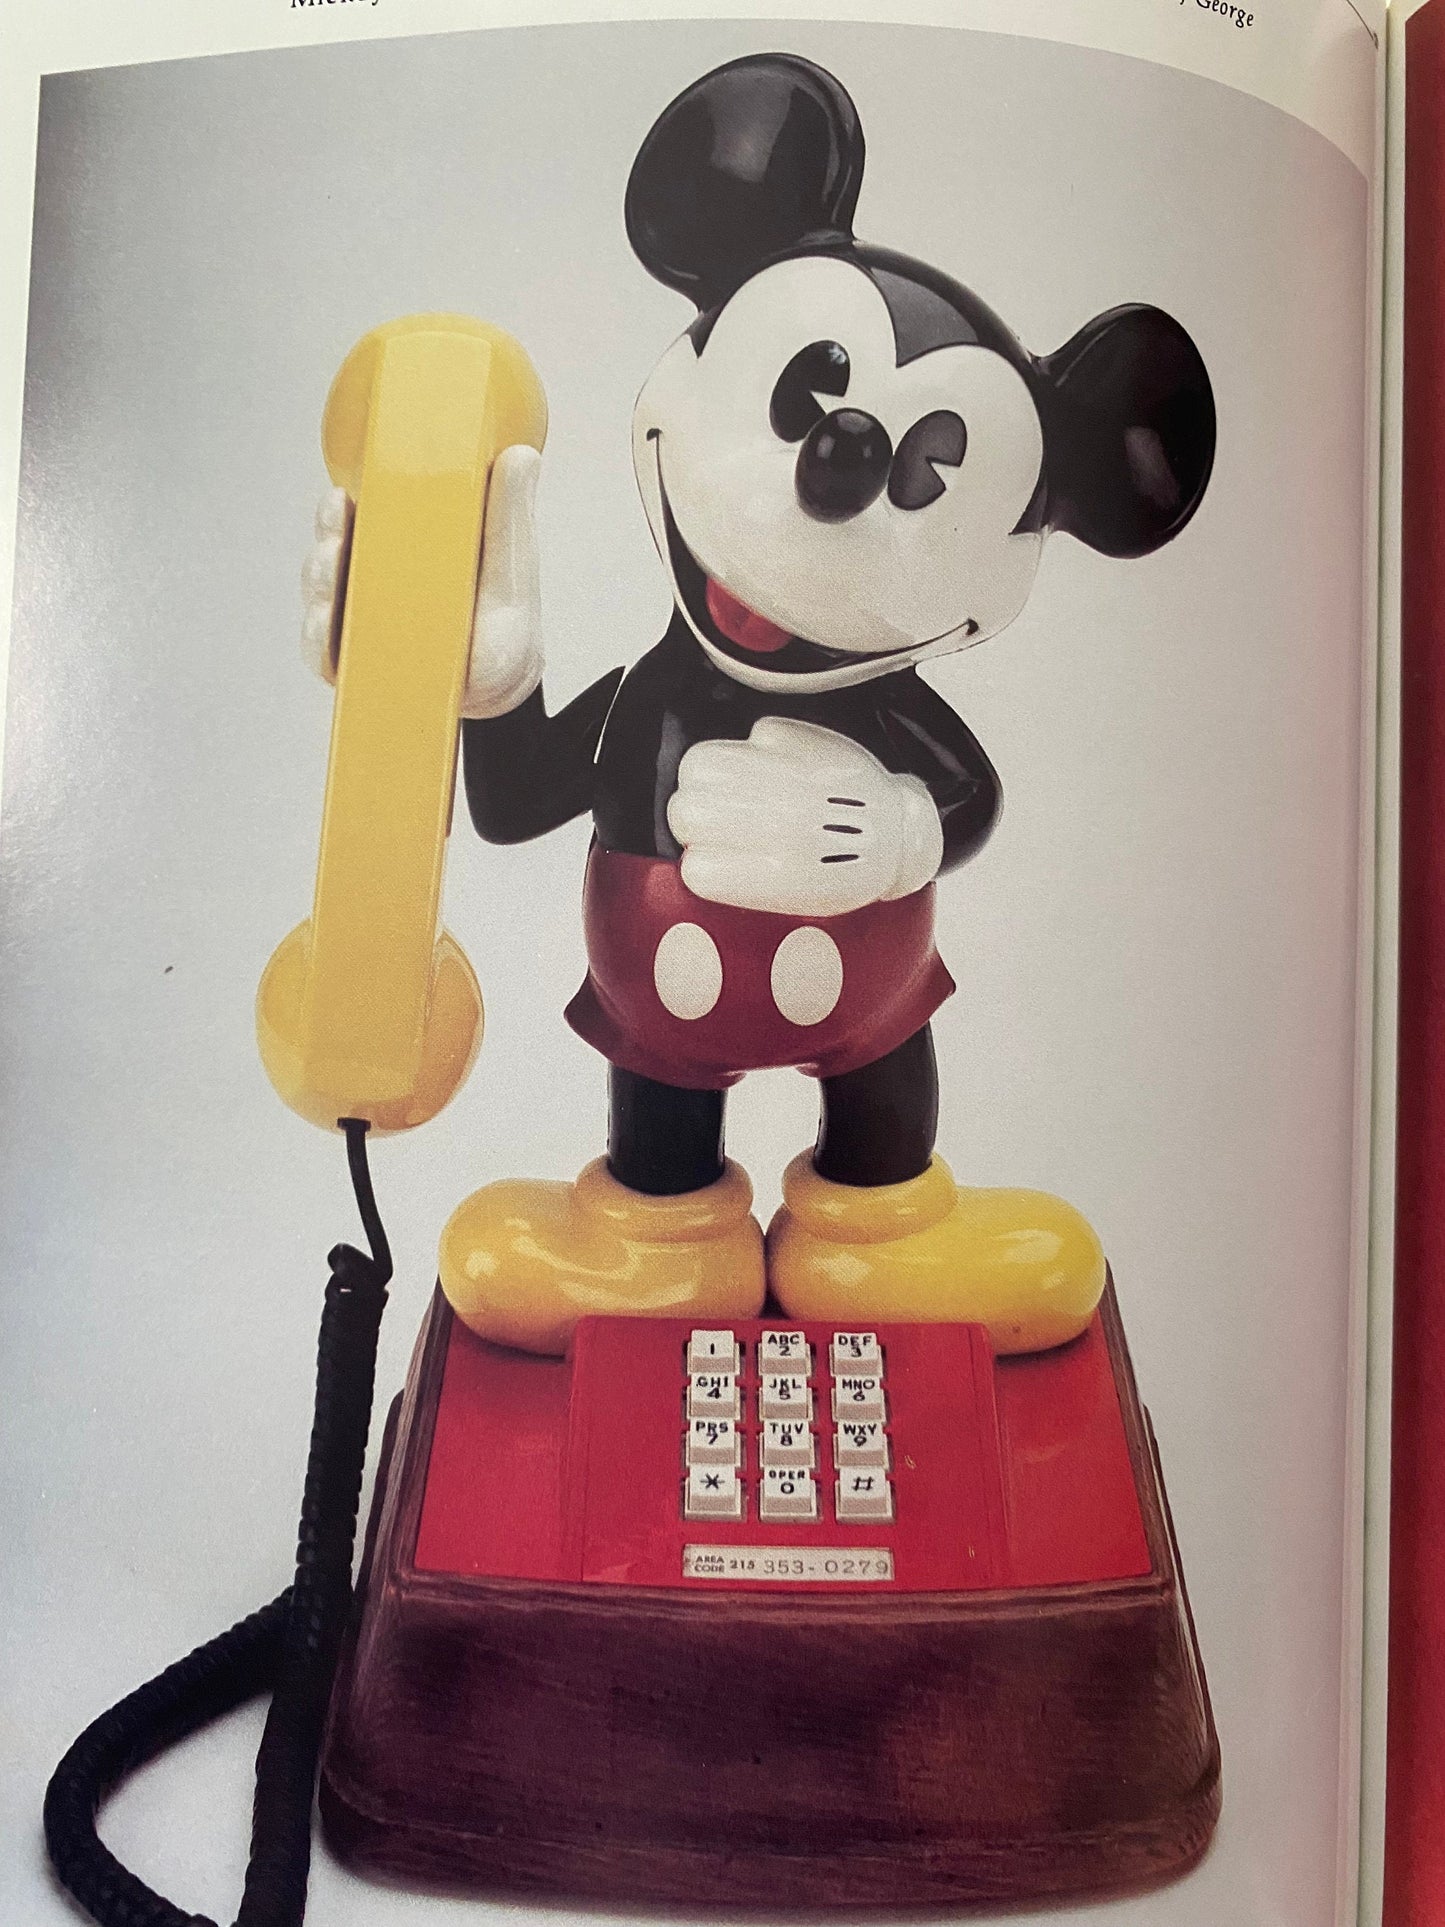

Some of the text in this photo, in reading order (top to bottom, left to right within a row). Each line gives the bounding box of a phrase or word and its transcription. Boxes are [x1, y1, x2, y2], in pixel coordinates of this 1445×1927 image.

[767, 1334, 801, 1345] ABC
[838, 1335, 873, 1346] DEF
[779, 1346, 791, 1356] 2
[850, 1347, 863, 1358] 3
[698, 1376, 729, 1388] GHI
[769, 1378, 801, 1389] JKL
[842, 1379, 876, 1390] MNO
[707, 1387, 721, 1400] 4
[778, 1389, 791, 1401] 5
[852, 1390, 866, 1402] 6
[695, 1421, 729, 1433] PRS
[770, 1422, 804, 1434] TUV
[843, 1424, 877, 1435] WXY
[706, 1433, 719, 1445] 7
[779, 1434, 793, 1447] 8
[853, 1435, 867, 1448] 9
[695, 1555, 725, 1564] AREA
[694, 1564, 725, 1573] CODE
